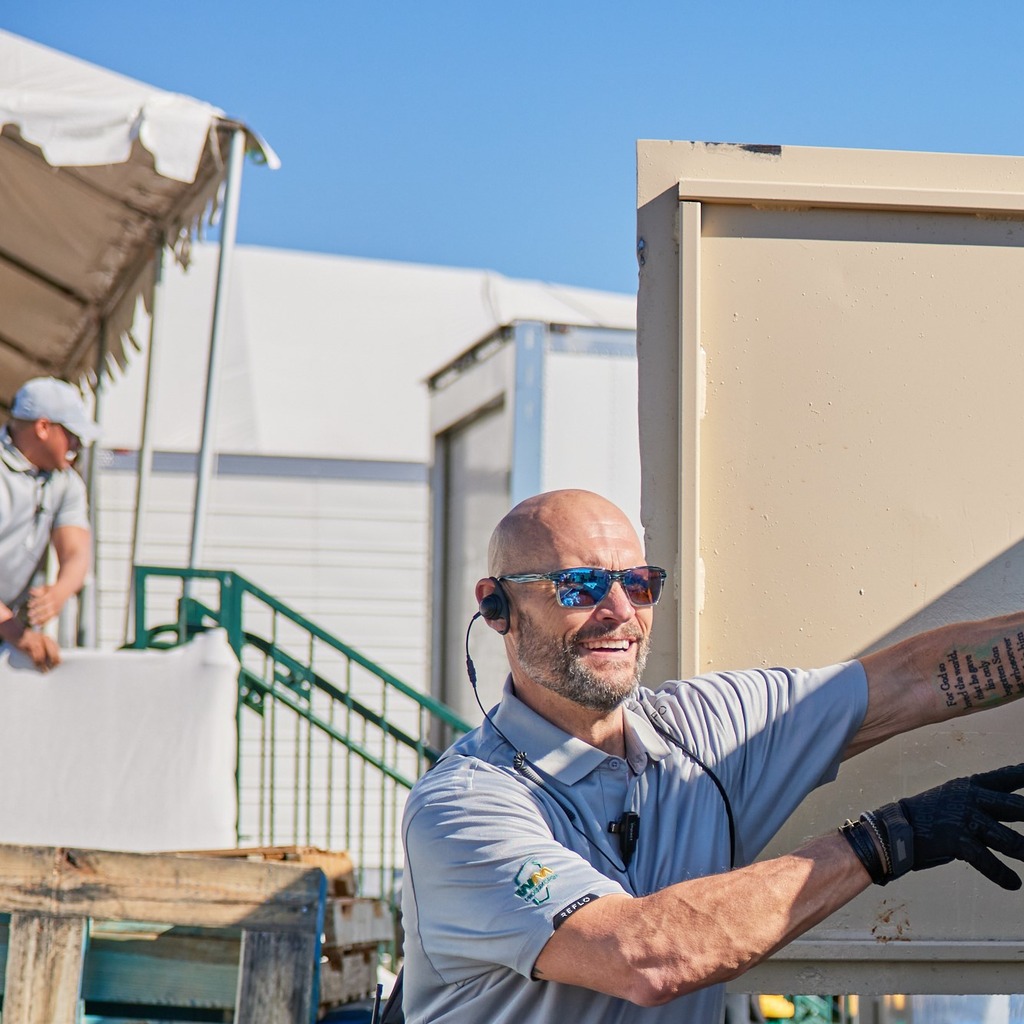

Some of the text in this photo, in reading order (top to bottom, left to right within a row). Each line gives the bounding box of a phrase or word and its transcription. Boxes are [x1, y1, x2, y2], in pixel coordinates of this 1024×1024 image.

[991, 646, 1001, 665] Son
[937, 673, 950, 690] God
[954, 676, 965, 690] the
[978, 660, 996, 691] his only
[946, 692, 957, 707] For
[560, 896, 591, 917] REFLO
